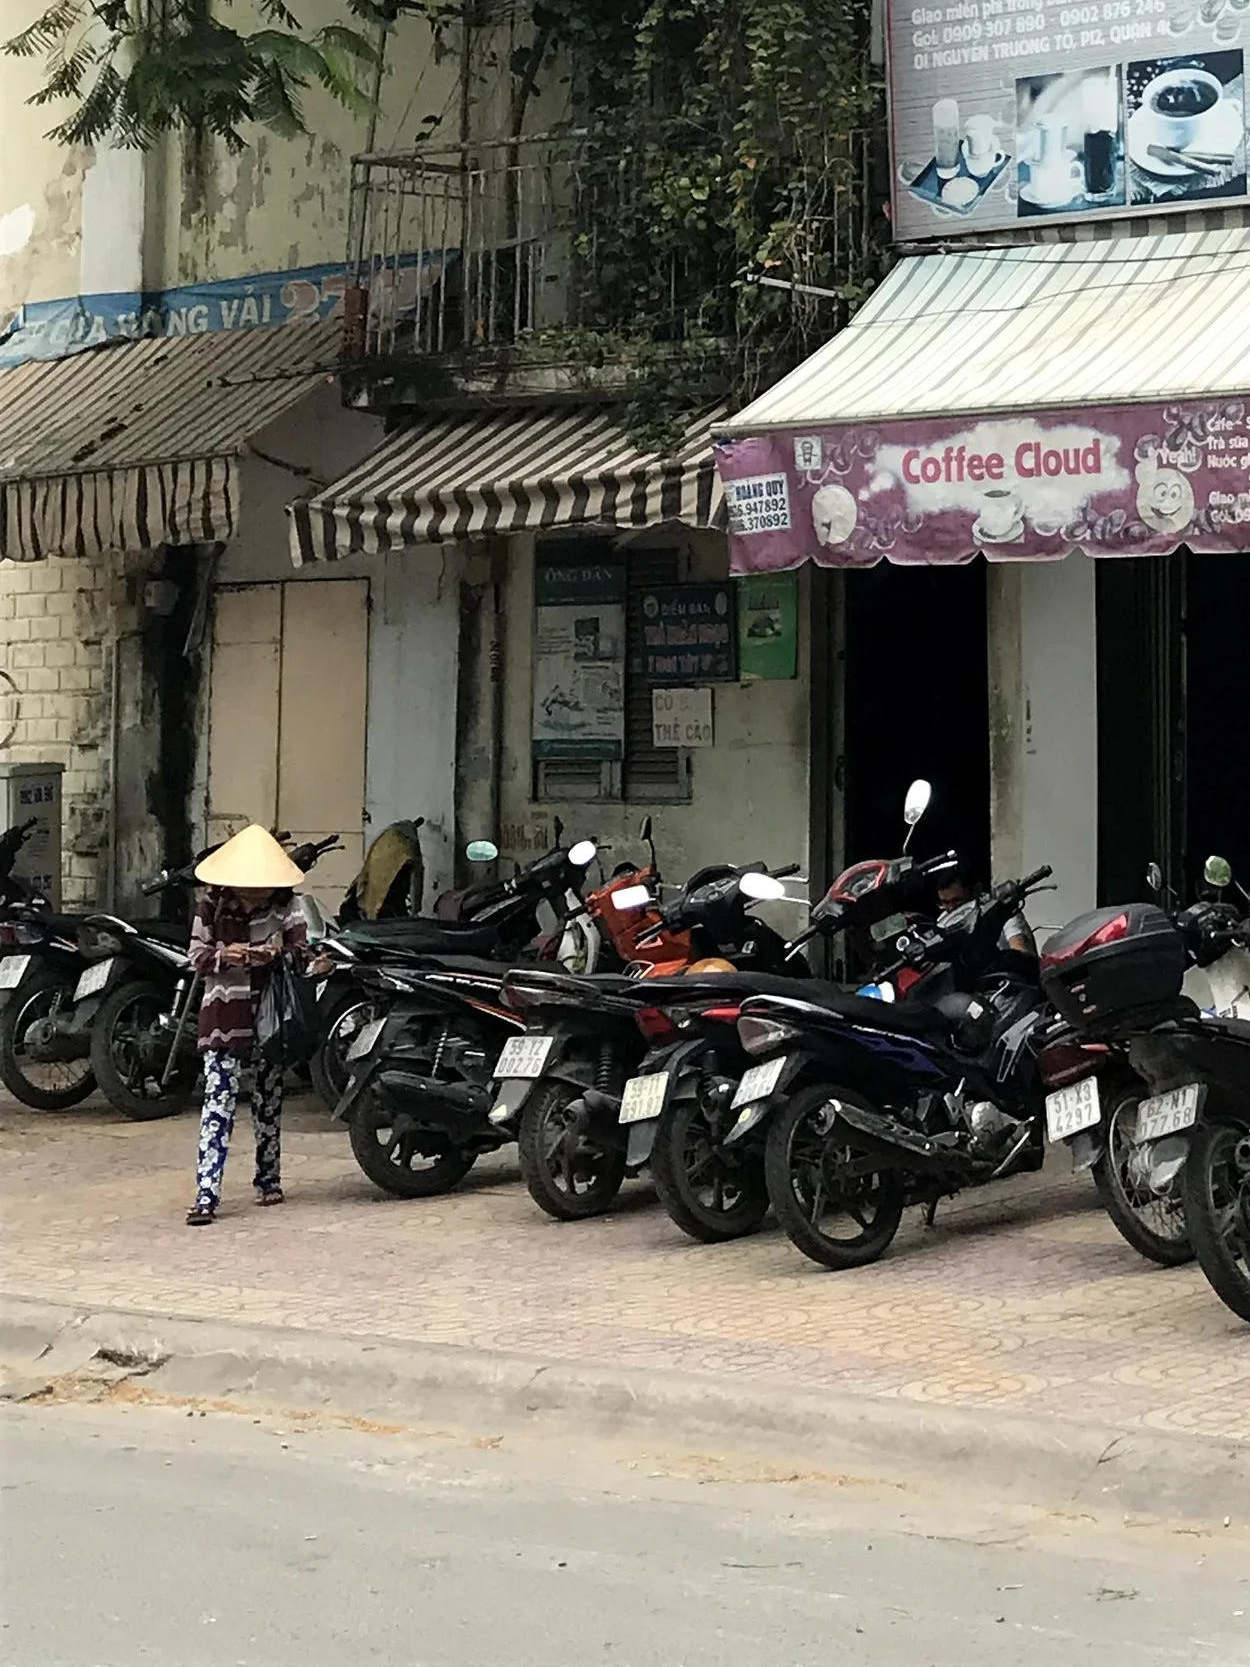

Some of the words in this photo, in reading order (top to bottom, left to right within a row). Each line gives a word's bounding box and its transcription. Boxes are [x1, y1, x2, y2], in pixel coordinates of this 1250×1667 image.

[986, 16, 1012, 38] 307
[1015, 13, 1046, 35] 890
[901, 445, 1005, 485] Coffee
[1014, 438, 1102, 479] Cloud
[1055, 1102, 1093, 1133] 4297
